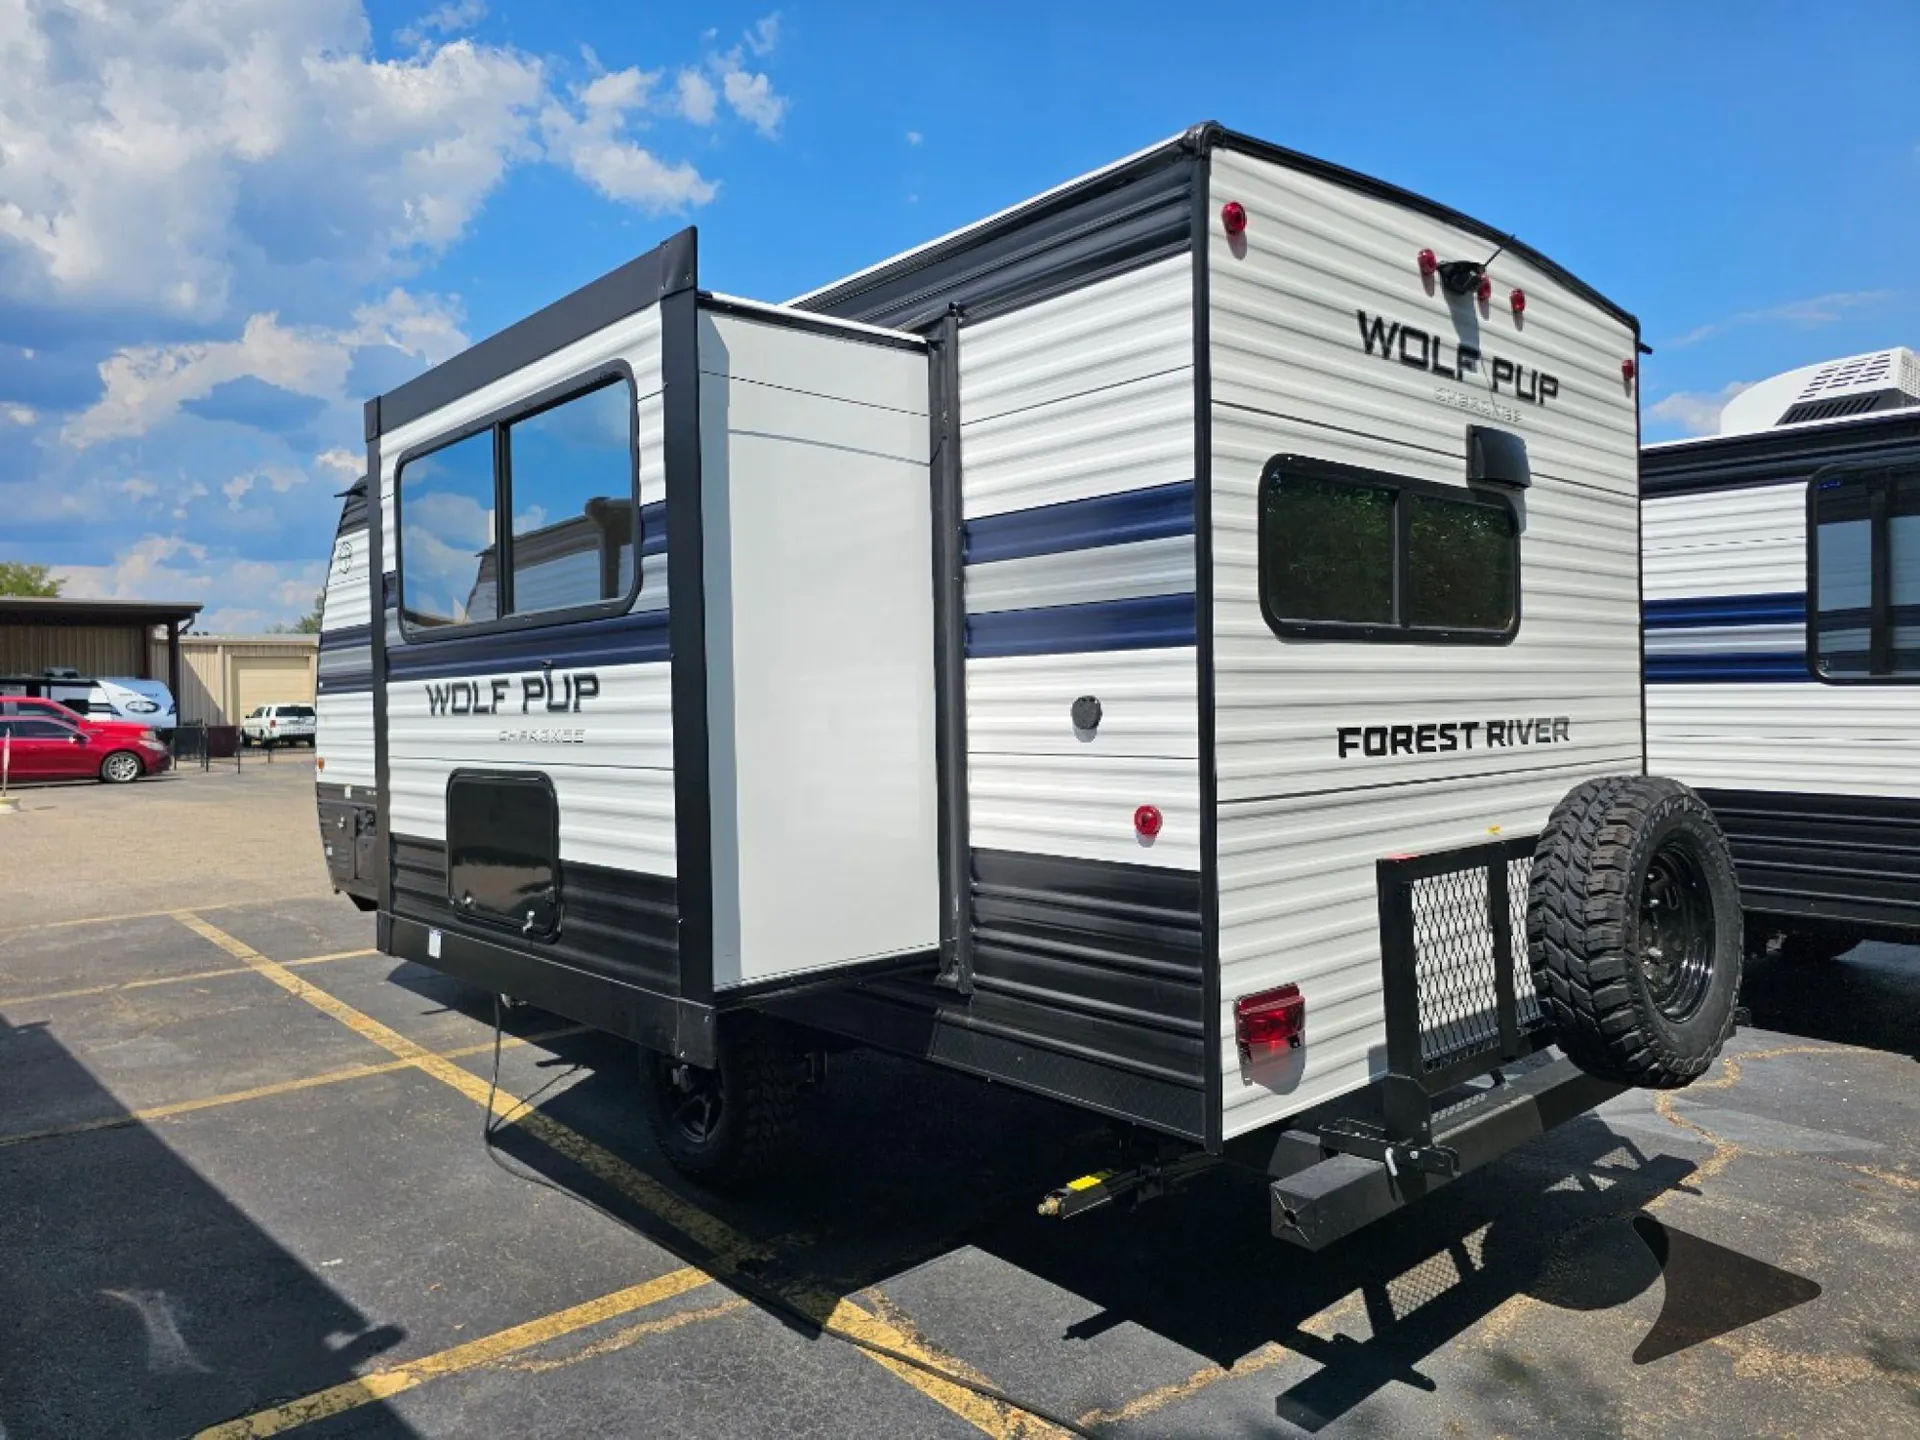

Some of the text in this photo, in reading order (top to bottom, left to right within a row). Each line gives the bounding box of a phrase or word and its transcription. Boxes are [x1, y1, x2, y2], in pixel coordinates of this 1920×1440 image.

[1357, 309, 1559, 406] WOLF PUP
[425, 672, 599, 717] WOLF PUP
[1337, 716, 1570, 758] FOREST RIVER
